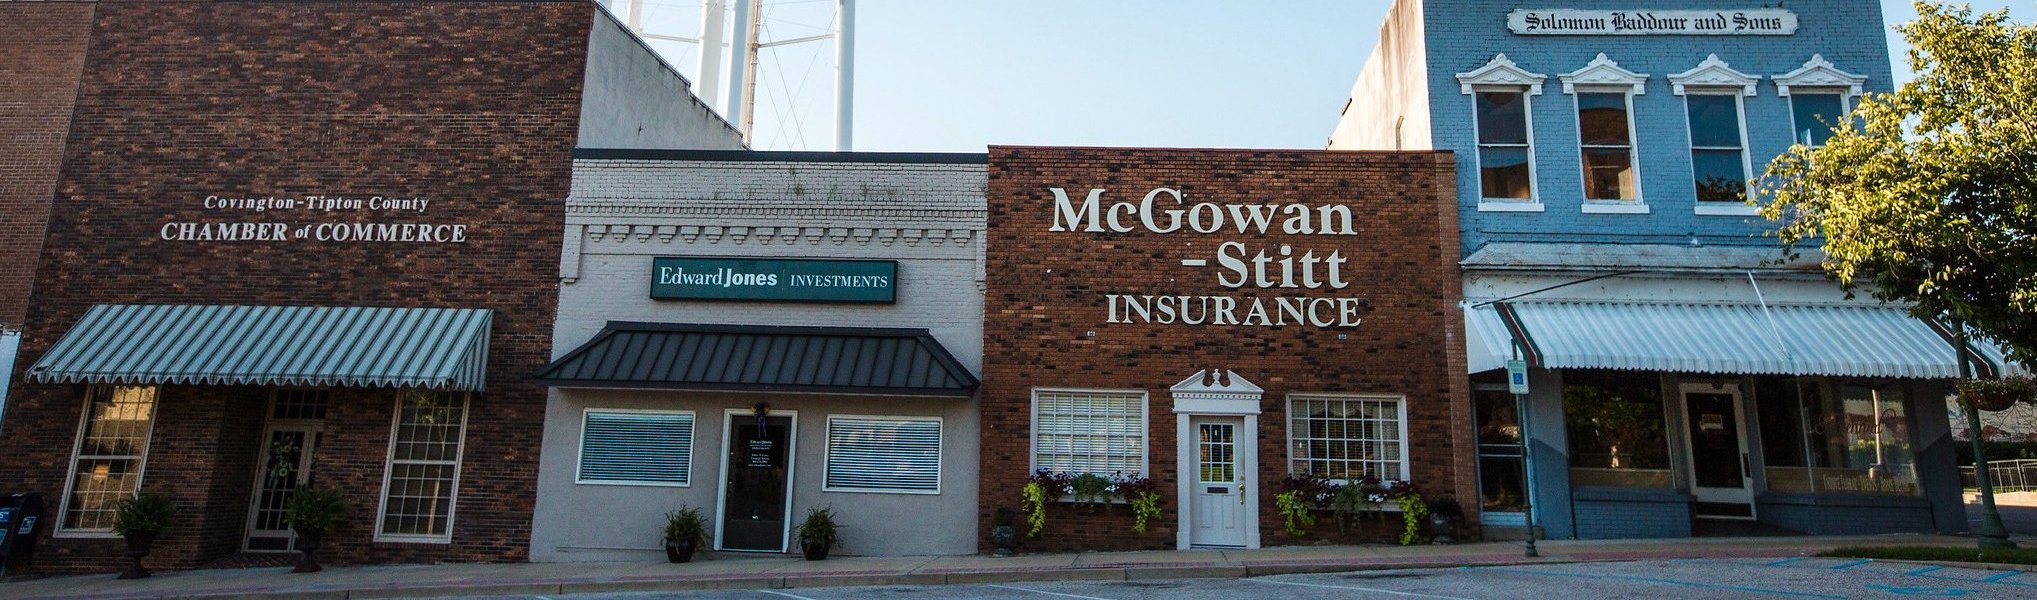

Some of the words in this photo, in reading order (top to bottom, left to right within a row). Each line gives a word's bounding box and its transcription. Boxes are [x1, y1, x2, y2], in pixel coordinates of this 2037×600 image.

[1525, 12, 1605, 32] Solomon
[1611, 12, 1687, 32] Baddour
[1694, 12, 1727, 30] and
[1732, 12, 1781, 32] Sons
[204, 195, 362, 212] Covington-Tipton
[369, 196, 429, 212] County
[1049, 187, 1358, 235] McGowan
[160, 222, 288, 241] CHAMBER
[295, 224, 313, 239] of
[315, 223, 467, 243] COMMERCE
[790, 274, 888, 288] INVESTMENTS
[1105, 294, 1361, 327] INSURANCE
